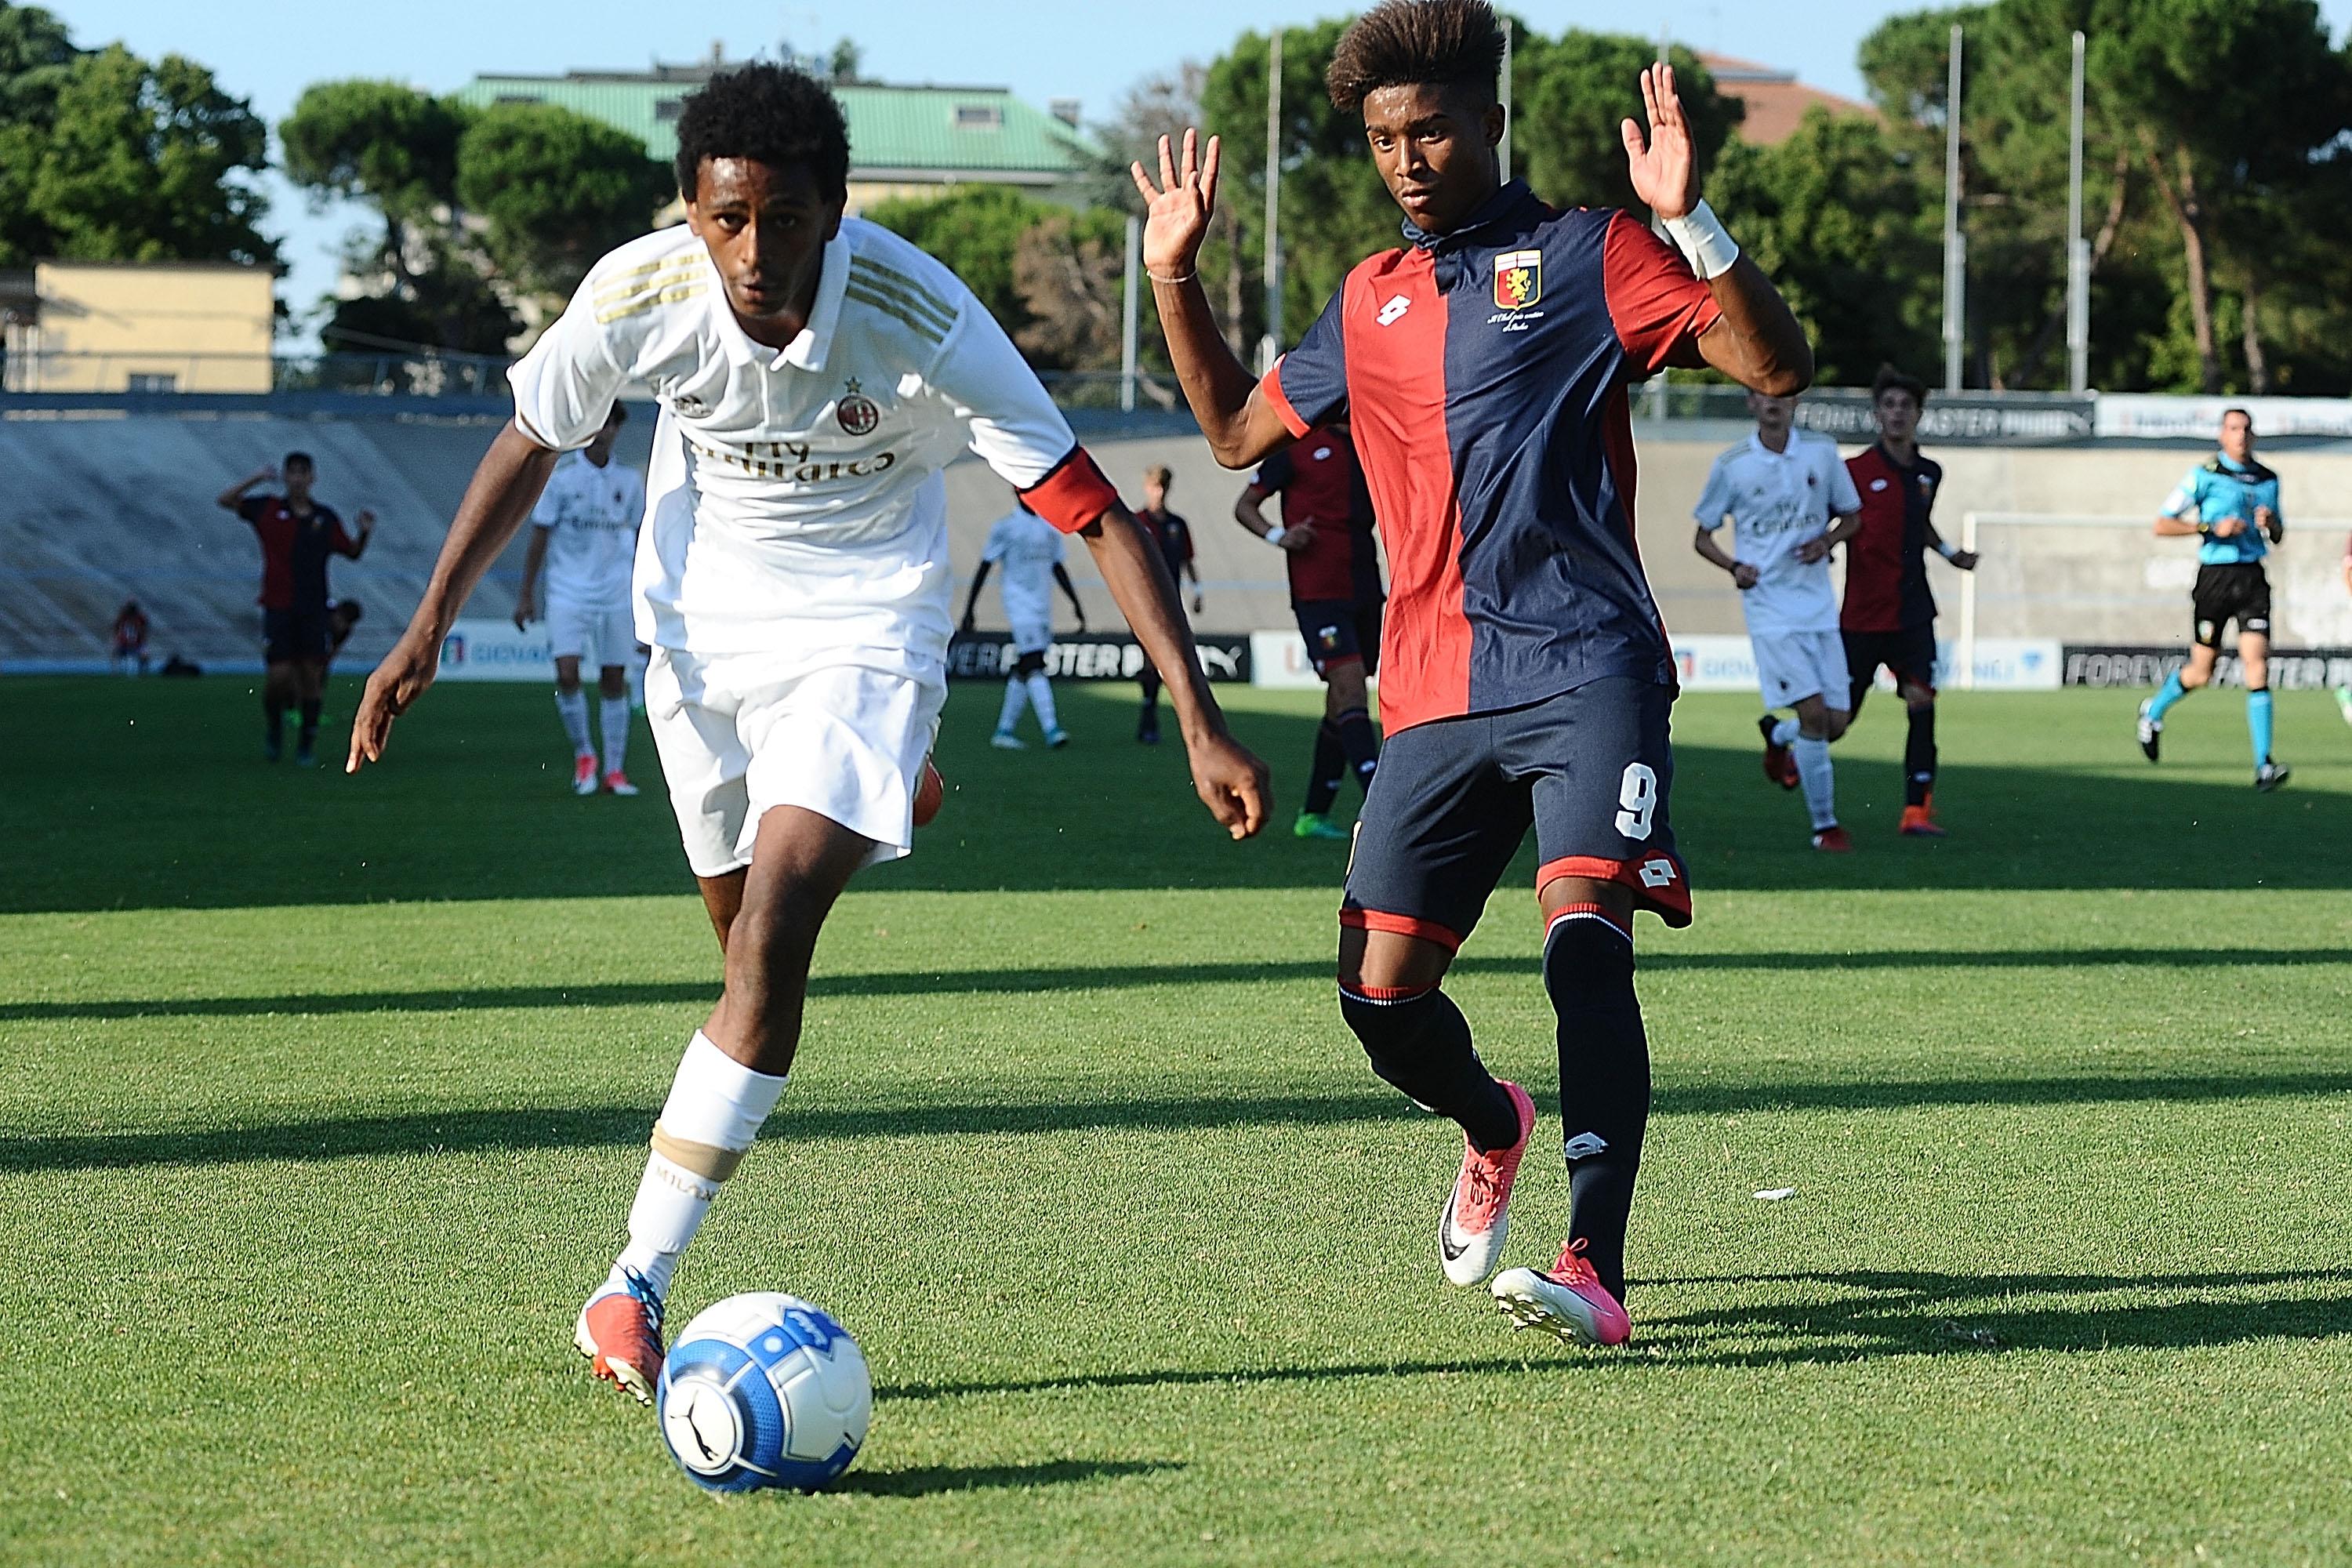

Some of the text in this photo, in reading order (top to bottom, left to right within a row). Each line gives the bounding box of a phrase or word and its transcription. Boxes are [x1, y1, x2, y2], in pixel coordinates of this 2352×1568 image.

[1000, 643, 1120, 677] FSTER
[2065, 654, 2189, 688] FOREV
[1615, 762, 1657, 840] 9
